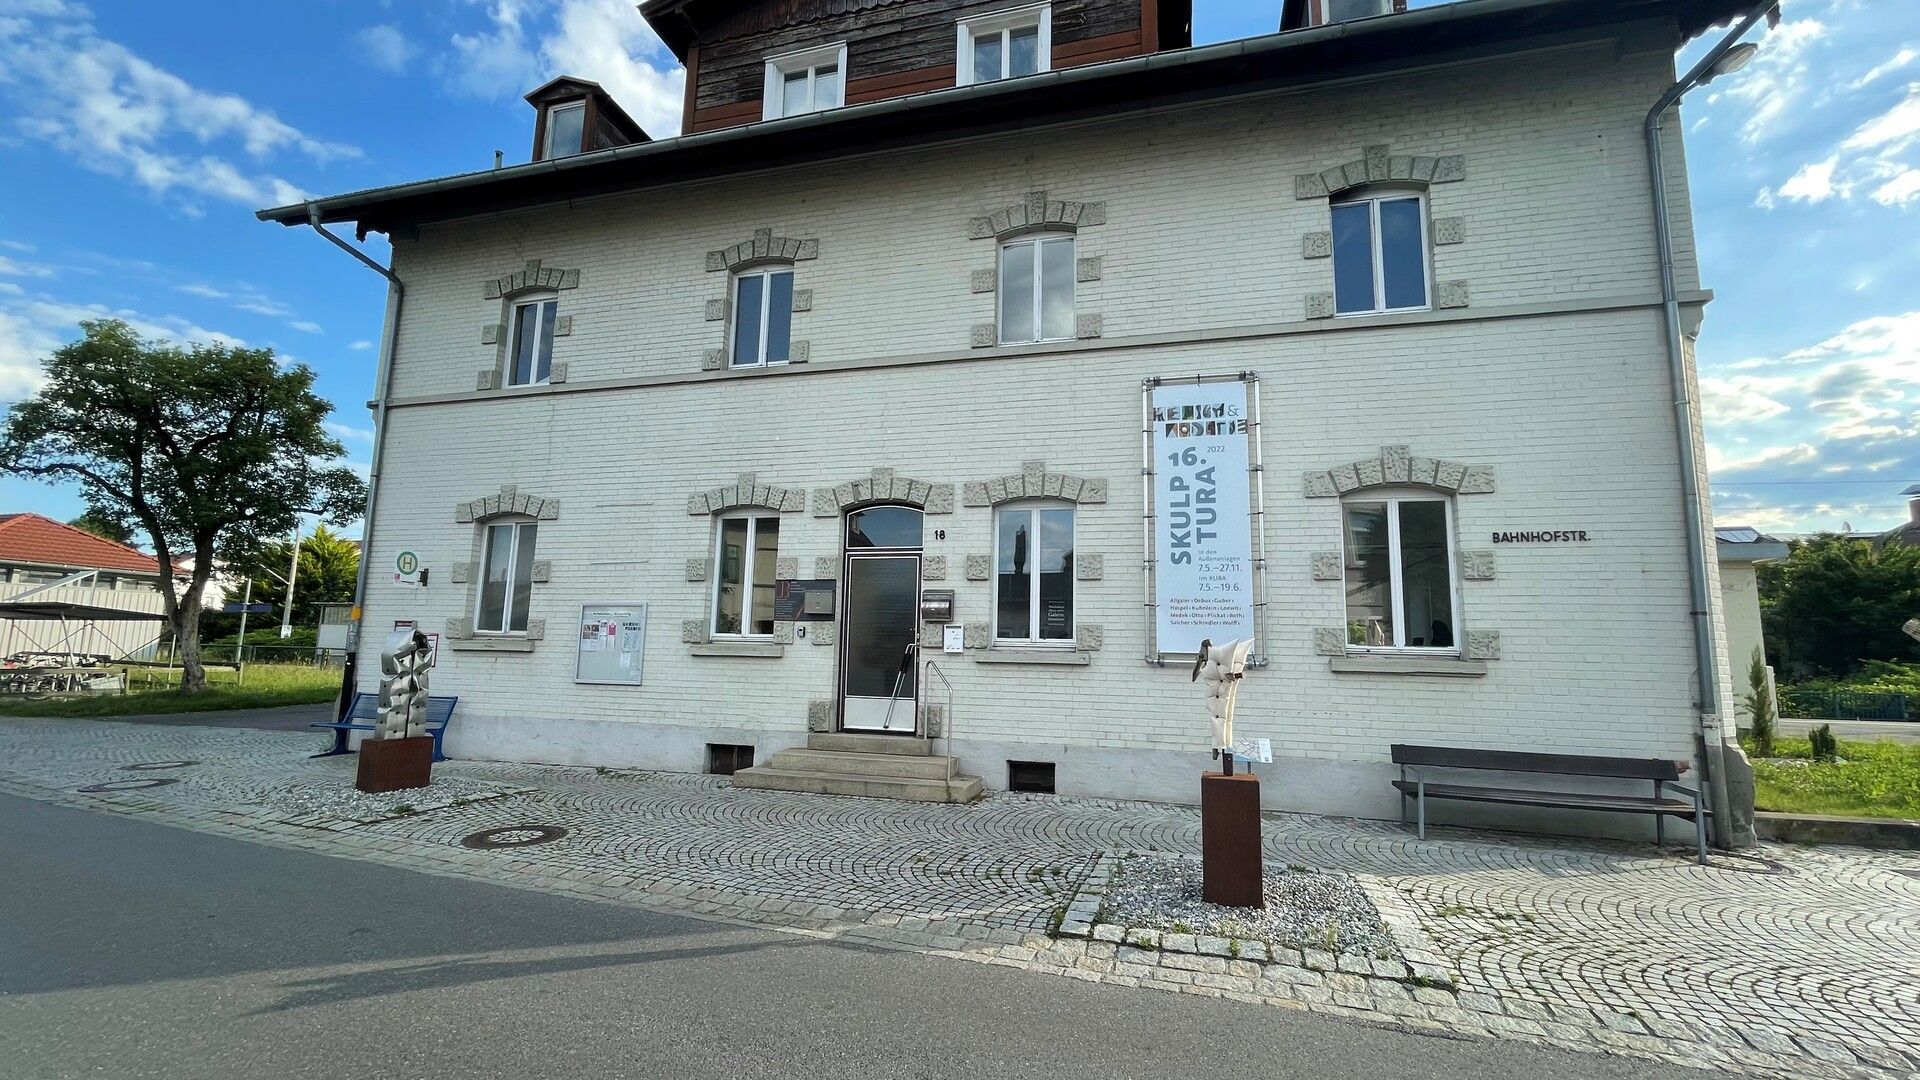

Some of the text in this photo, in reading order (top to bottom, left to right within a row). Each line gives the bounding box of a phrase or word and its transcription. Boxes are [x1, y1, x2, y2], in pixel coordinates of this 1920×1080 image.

[1227, 405, 1239, 417] &
[1168, 446, 1206, 466] 16.
[1195, 466, 1217, 544] TURA
[1170, 476, 1191, 564] SKULP
[934, 529, 946, 541] 18
[1492, 530, 1592, 543] BAHNHOFSTR.
[403, 557, 412, 570] H
